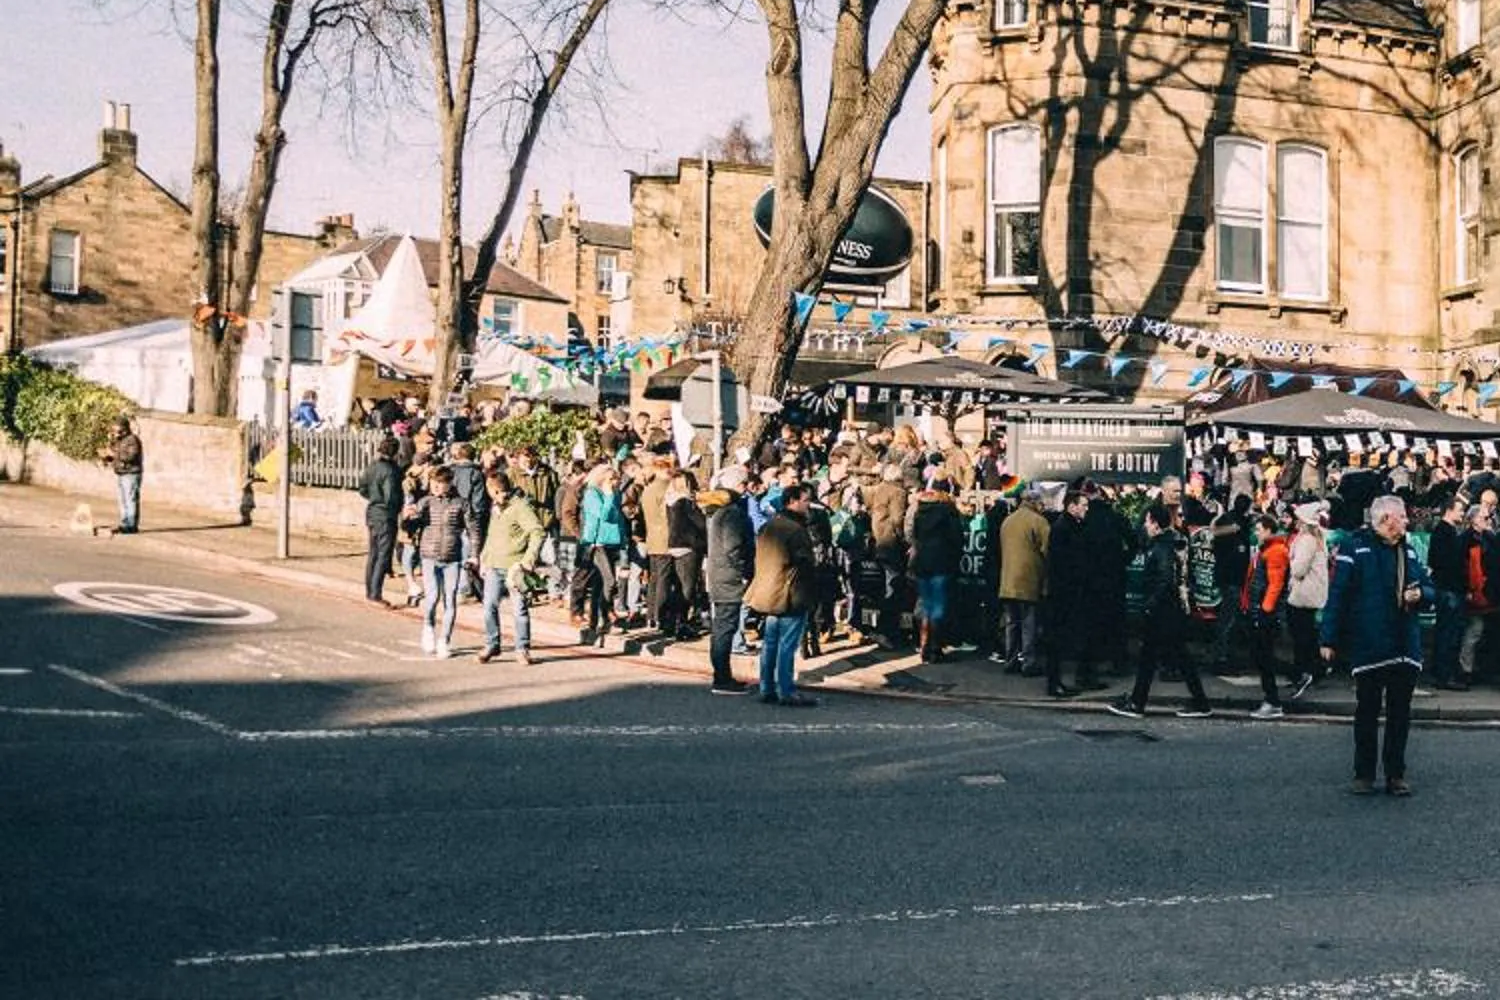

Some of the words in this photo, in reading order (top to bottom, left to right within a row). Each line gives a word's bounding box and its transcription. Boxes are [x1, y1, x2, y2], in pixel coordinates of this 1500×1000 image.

[836, 240, 873, 259] NESS
[1091, 453, 1113, 471] THE
[1117, 453, 1160, 473] BOTHY
